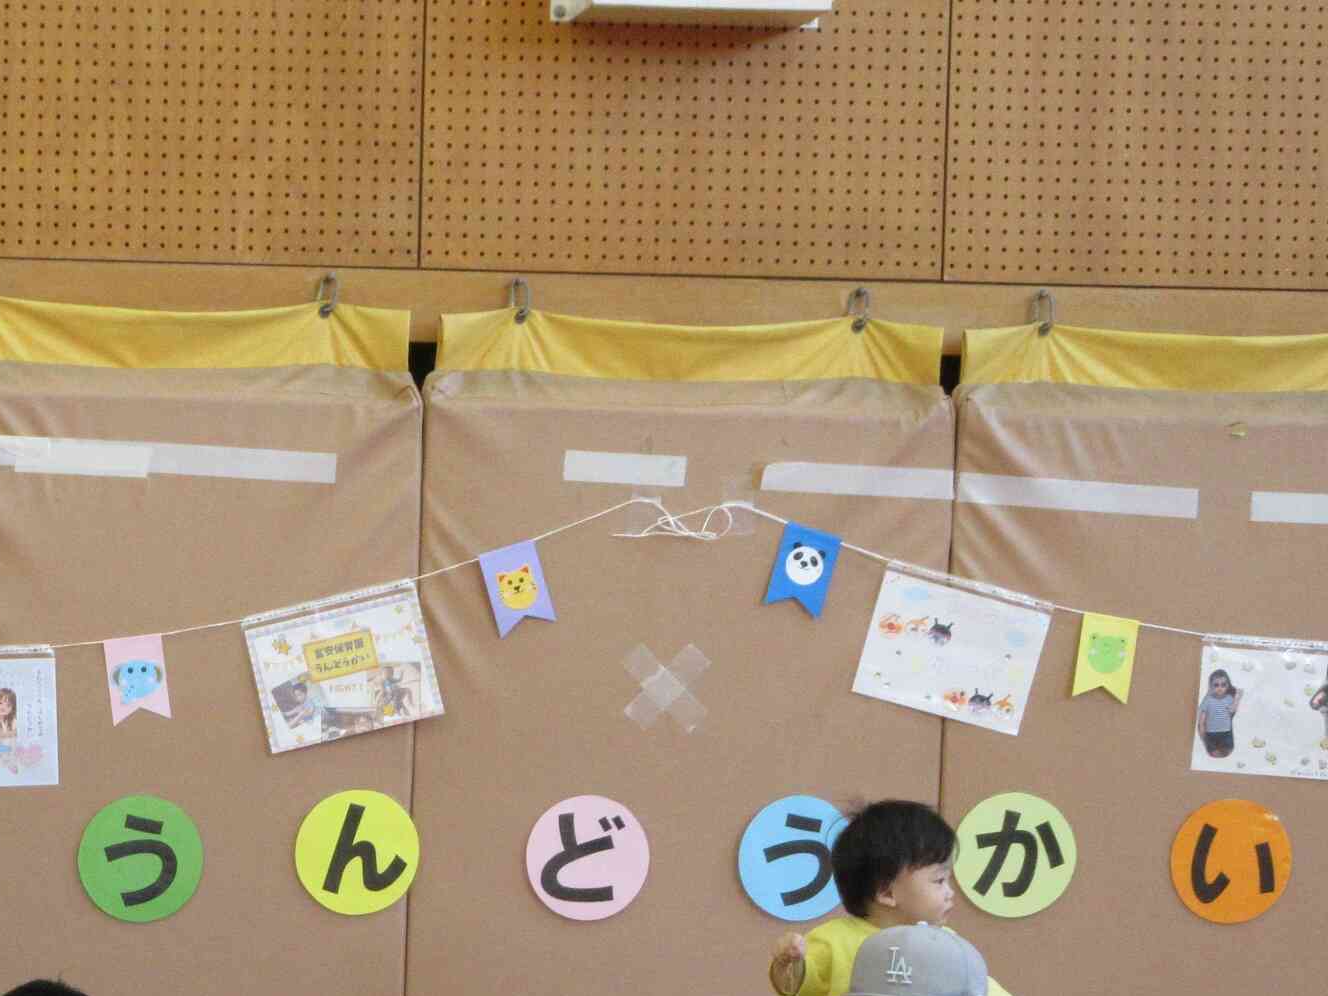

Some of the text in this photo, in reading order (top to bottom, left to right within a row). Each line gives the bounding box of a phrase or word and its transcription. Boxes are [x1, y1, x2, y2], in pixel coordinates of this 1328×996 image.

[104, 803, 1276, 907] うんどうかい
[886, 946, 913, 984] LA
